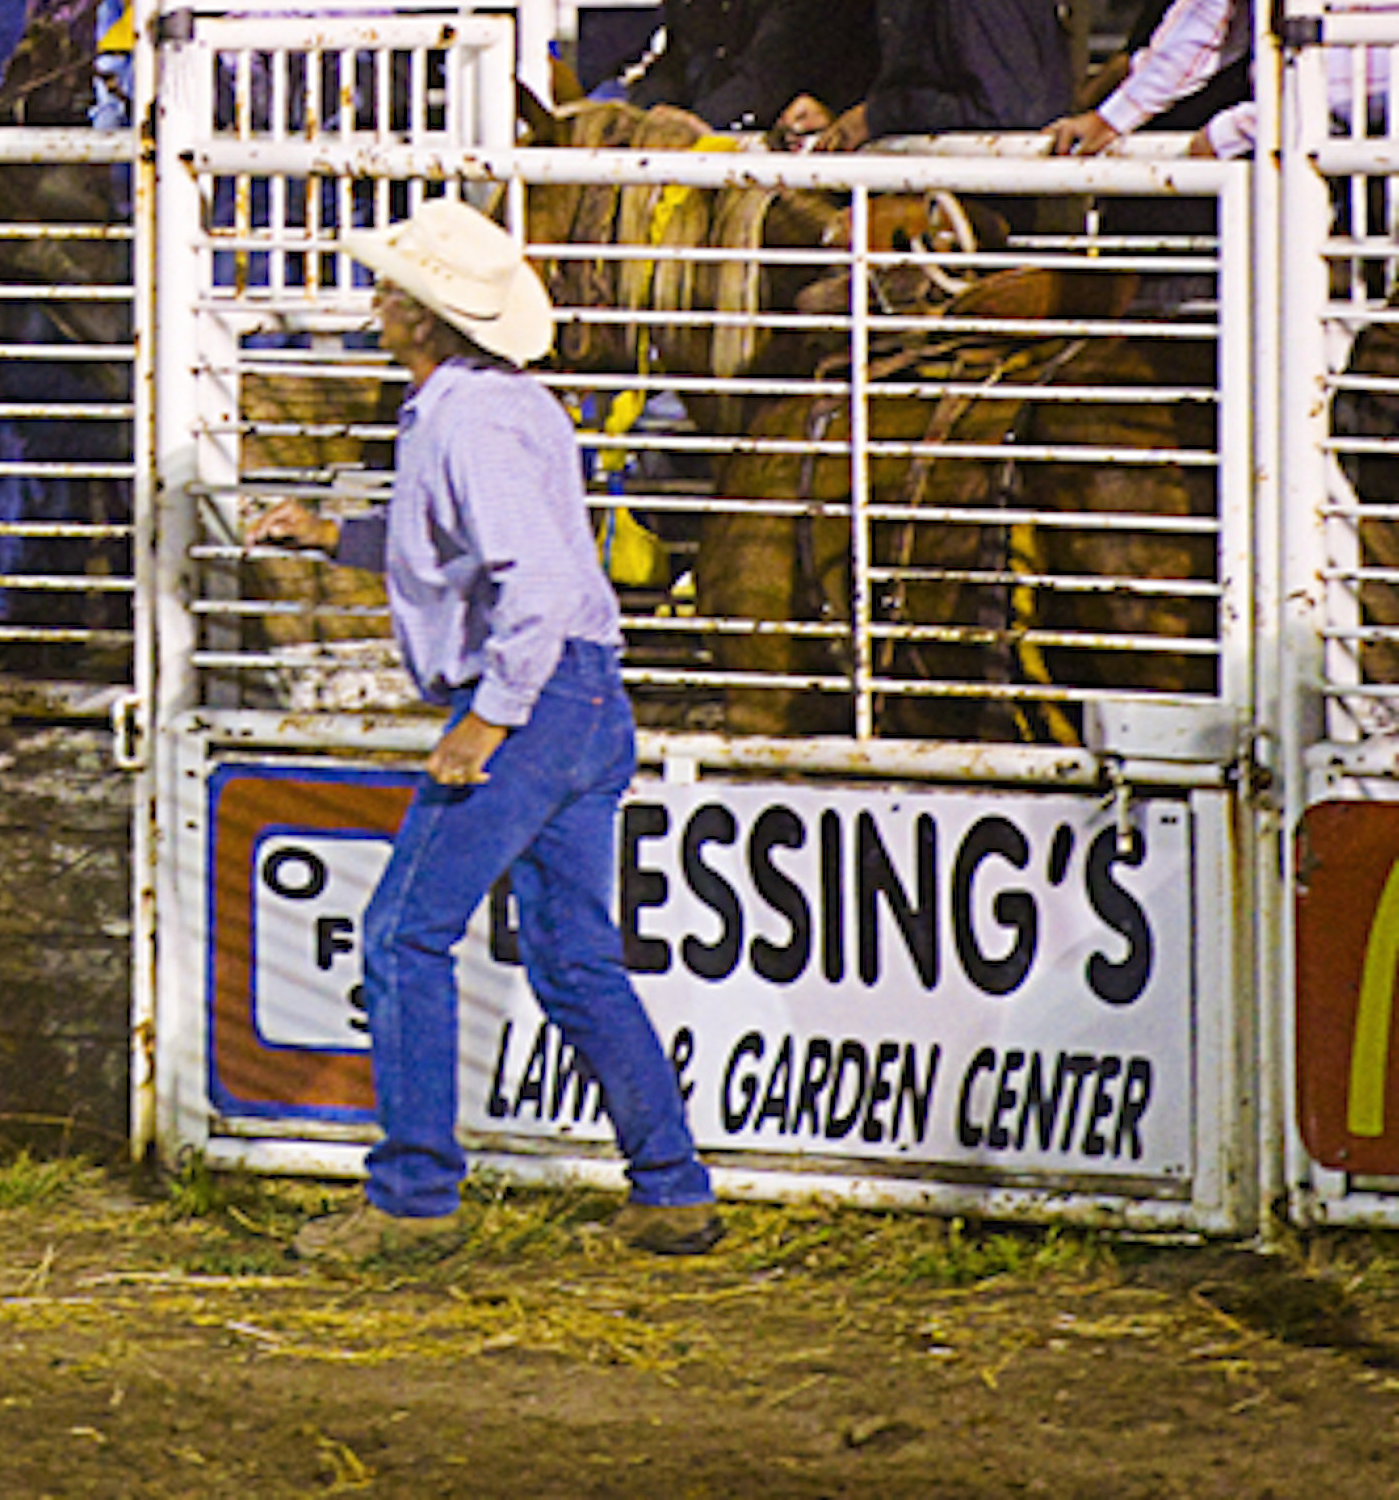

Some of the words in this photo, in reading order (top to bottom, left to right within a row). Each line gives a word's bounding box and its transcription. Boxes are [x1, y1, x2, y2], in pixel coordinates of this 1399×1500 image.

[489, 801, 1155, 1006] ESSING'S
[723, 1031, 944, 1150] GARDEN
[958, 1047, 1154, 1161] CENTER
